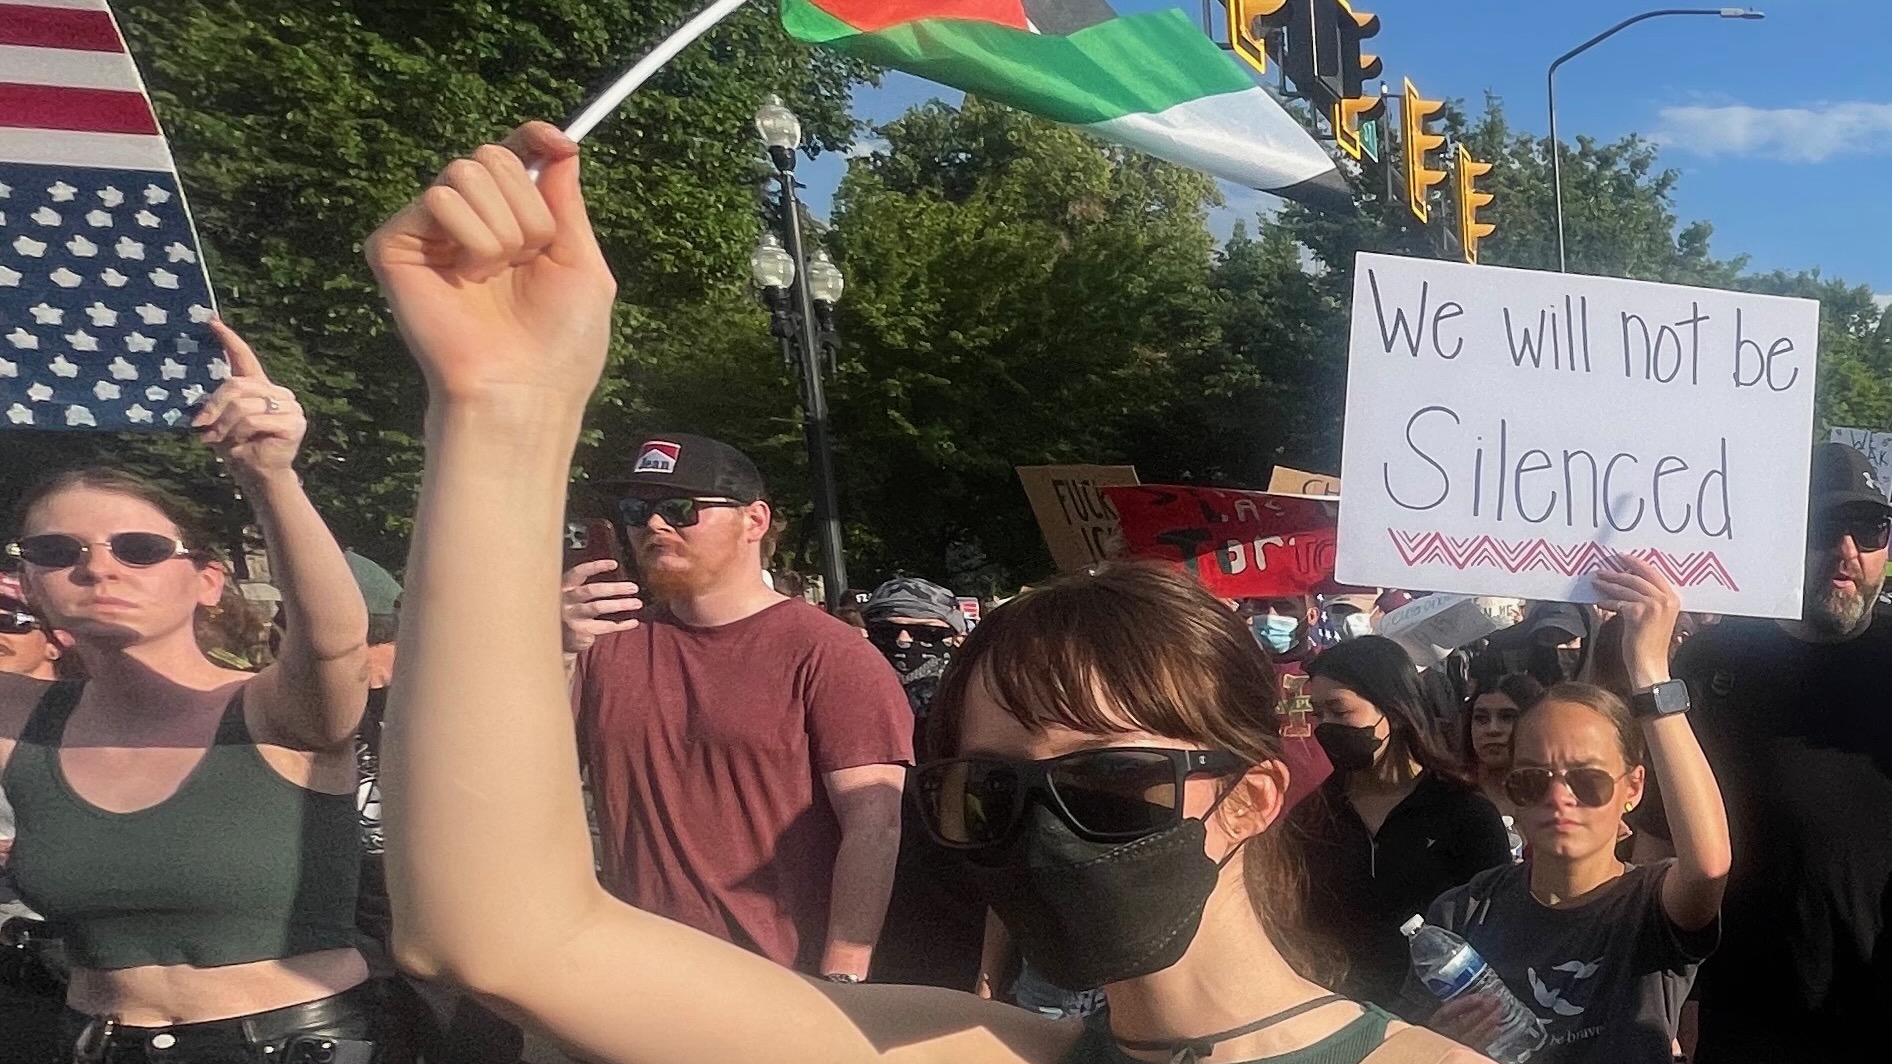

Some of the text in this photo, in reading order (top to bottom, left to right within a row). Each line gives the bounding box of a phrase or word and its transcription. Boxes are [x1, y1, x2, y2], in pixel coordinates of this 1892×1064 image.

[1368, 268, 1799, 392] We will not be
[1383, 405, 1733, 540] Silenced
